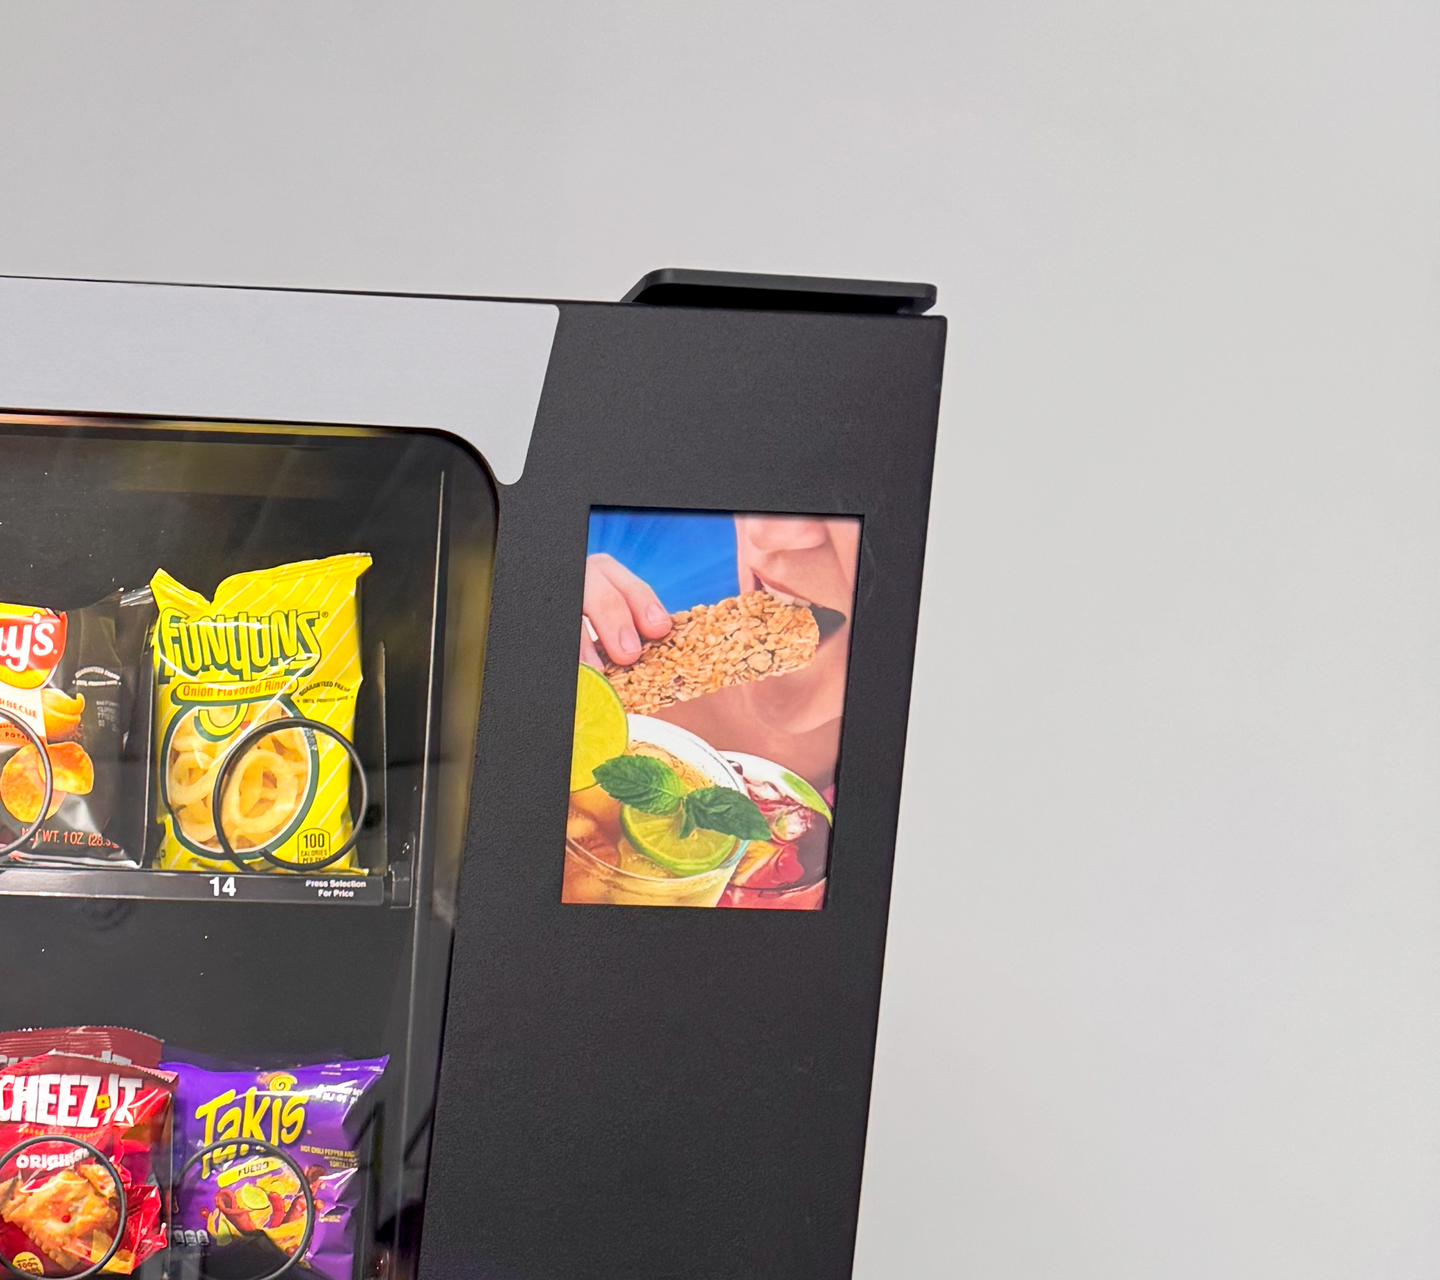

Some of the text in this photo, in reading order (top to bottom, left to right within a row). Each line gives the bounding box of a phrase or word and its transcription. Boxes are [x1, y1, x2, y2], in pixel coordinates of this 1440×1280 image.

[161, 608, 320, 681] FUNYUNS
[303, 833, 326, 849] 100
[209, 876, 237, 897] 14
[305, 879, 367, 889] Press Selection
[317, 888, 355, 898] For Price
